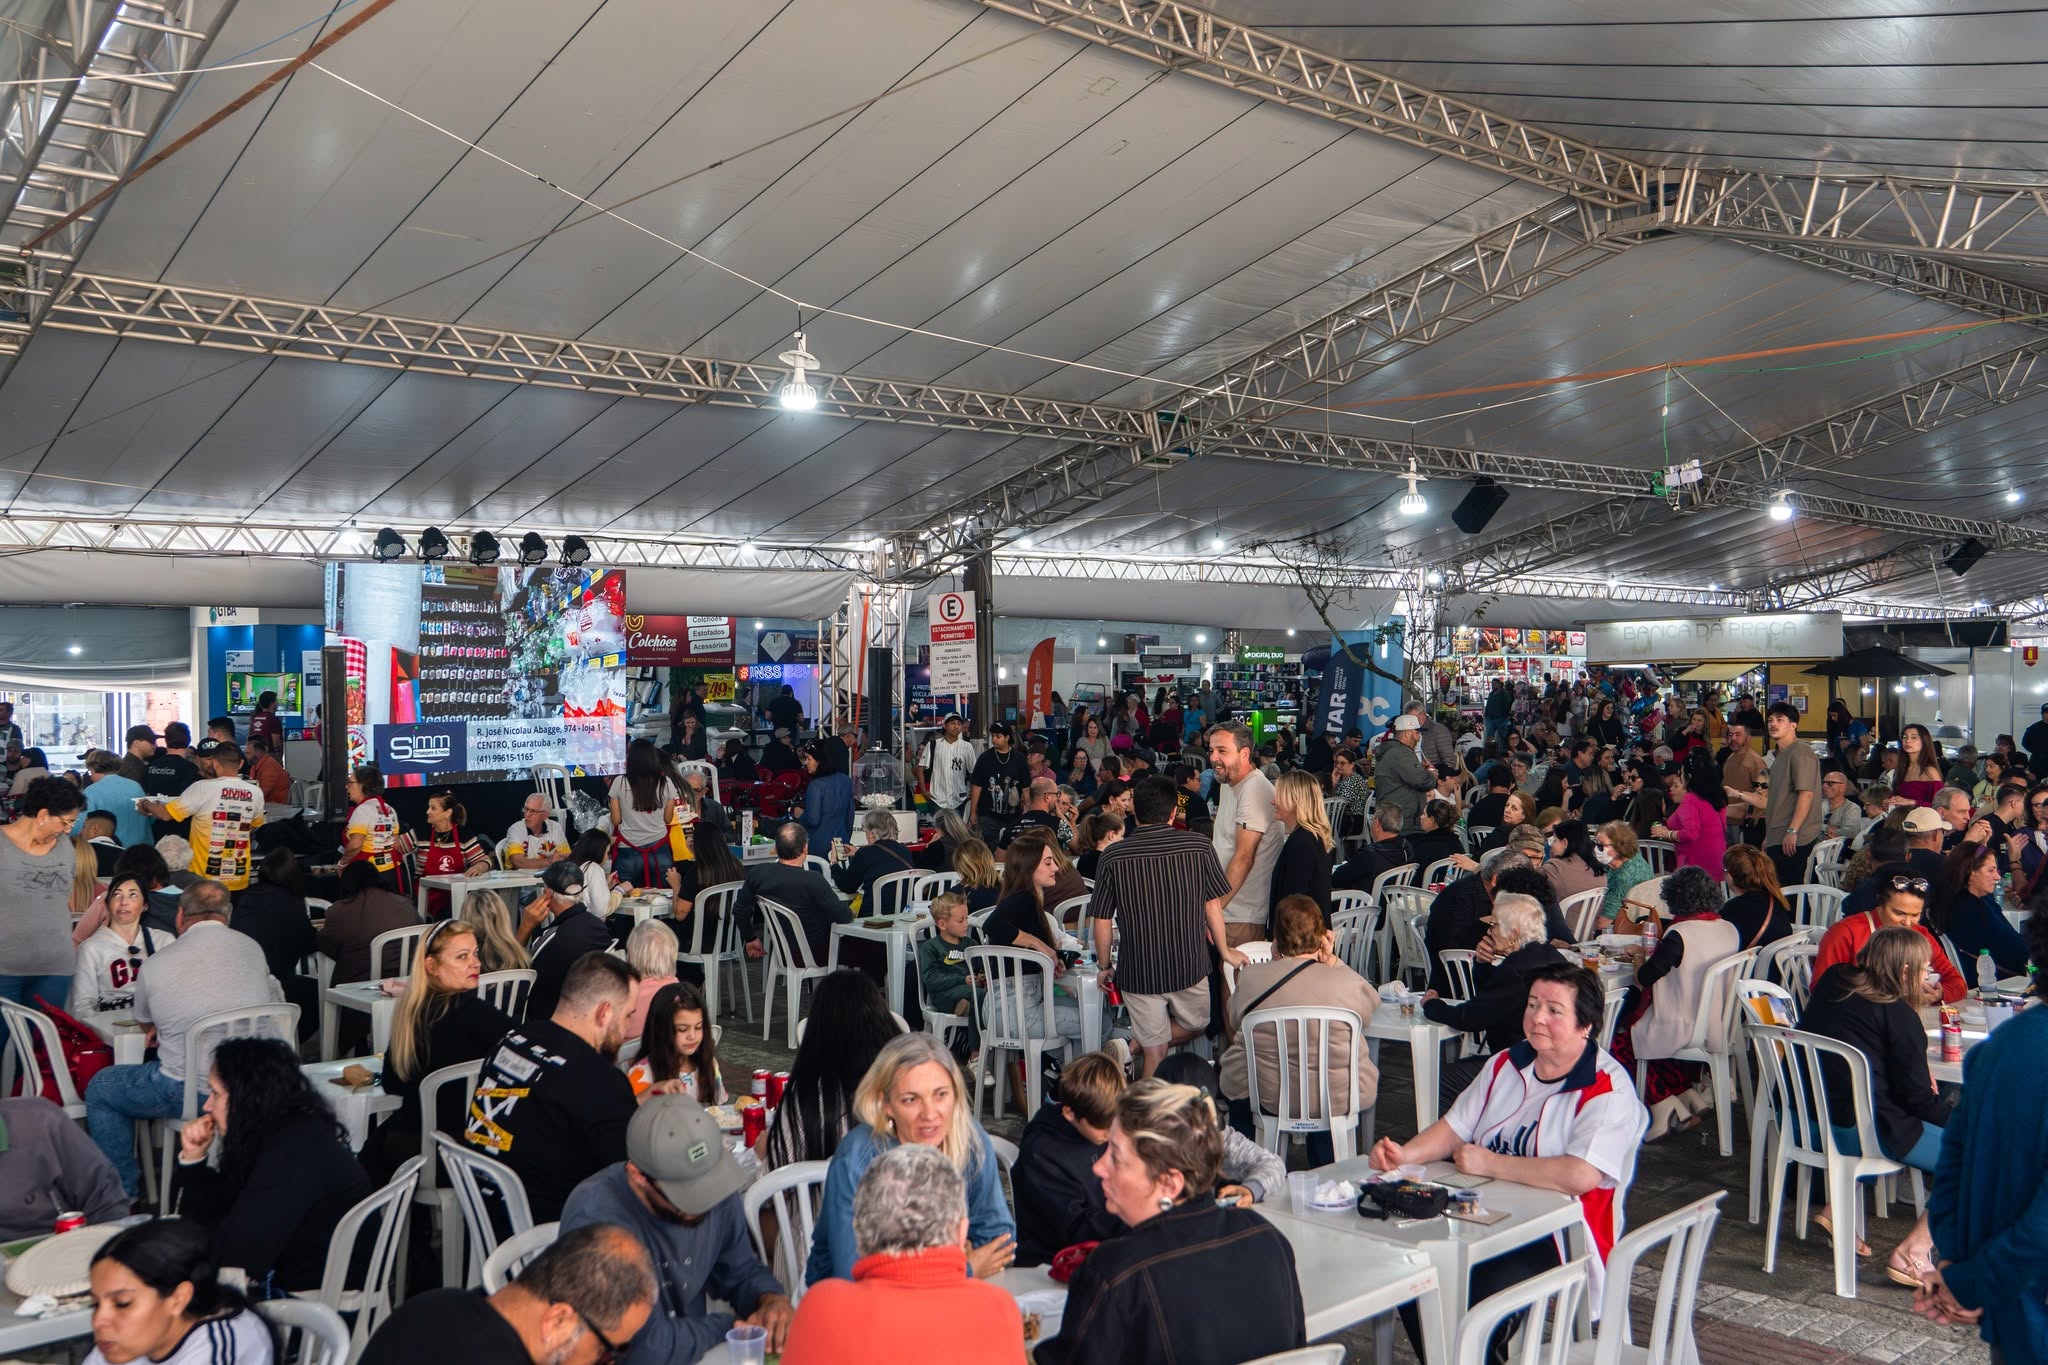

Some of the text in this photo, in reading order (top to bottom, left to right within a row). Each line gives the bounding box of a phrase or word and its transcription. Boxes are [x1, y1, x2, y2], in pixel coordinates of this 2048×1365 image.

[946, 599, 957, 617] E
[693, 629, 726, 637] Estofados
[932, 624, 973, 633] ESTACIONAMENTO
[1623, 624, 1693, 641] BANCA
[1695, 622, 1724, 639] DA
[1728, 620, 1797, 641] PRAÇA
[628, 631, 677, 649] Colchões
[693, 640, 729, 651] Acessórios
[477, 728, 484, 736] R.
[485, 727, 502, 737] José
[504, 726, 532, 736] Nicolau
[533, 726, 562, 737] Abagge,
[563, 725, 577, 733] 974
[581, 723, 595, 733] loja
[476, 740, 510, 750] CENTRO,
[511, 738, 551, 749] Guaratuba
[557, 738, 566, 746] PR
[476, 752, 534, 765] (41) 99615-1165
[148, 765, 175, 776] Técnica
[221, 788, 253, 800] DIVINO
